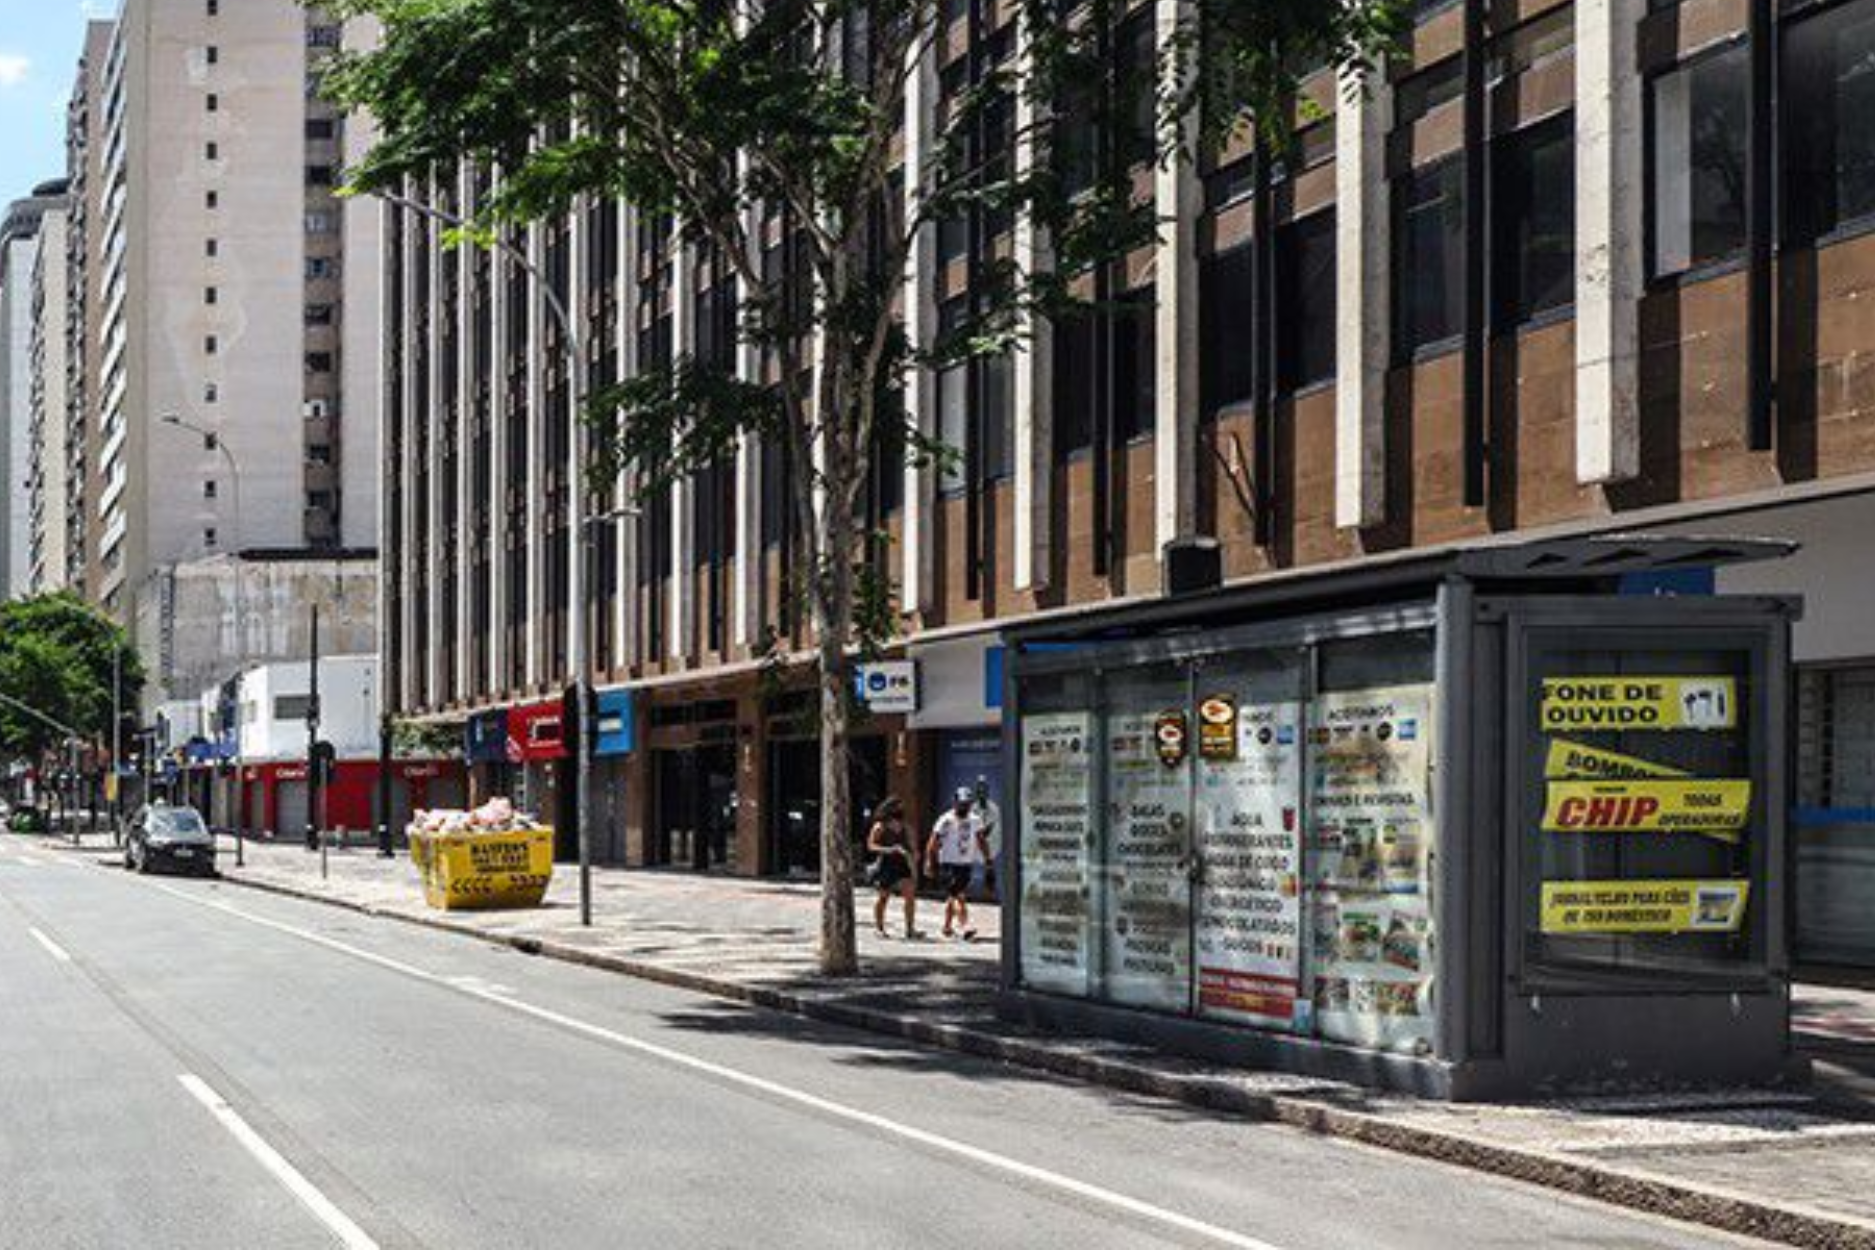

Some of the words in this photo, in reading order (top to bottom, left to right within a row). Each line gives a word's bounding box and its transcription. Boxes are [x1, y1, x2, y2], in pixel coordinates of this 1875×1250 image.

[1542, 684, 1615, 700] FONE
[1625, 684, 1662, 700] DE
[1548, 706, 1659, 722] OUVIDO
[1556, 797, 1659, 826] CHIP
